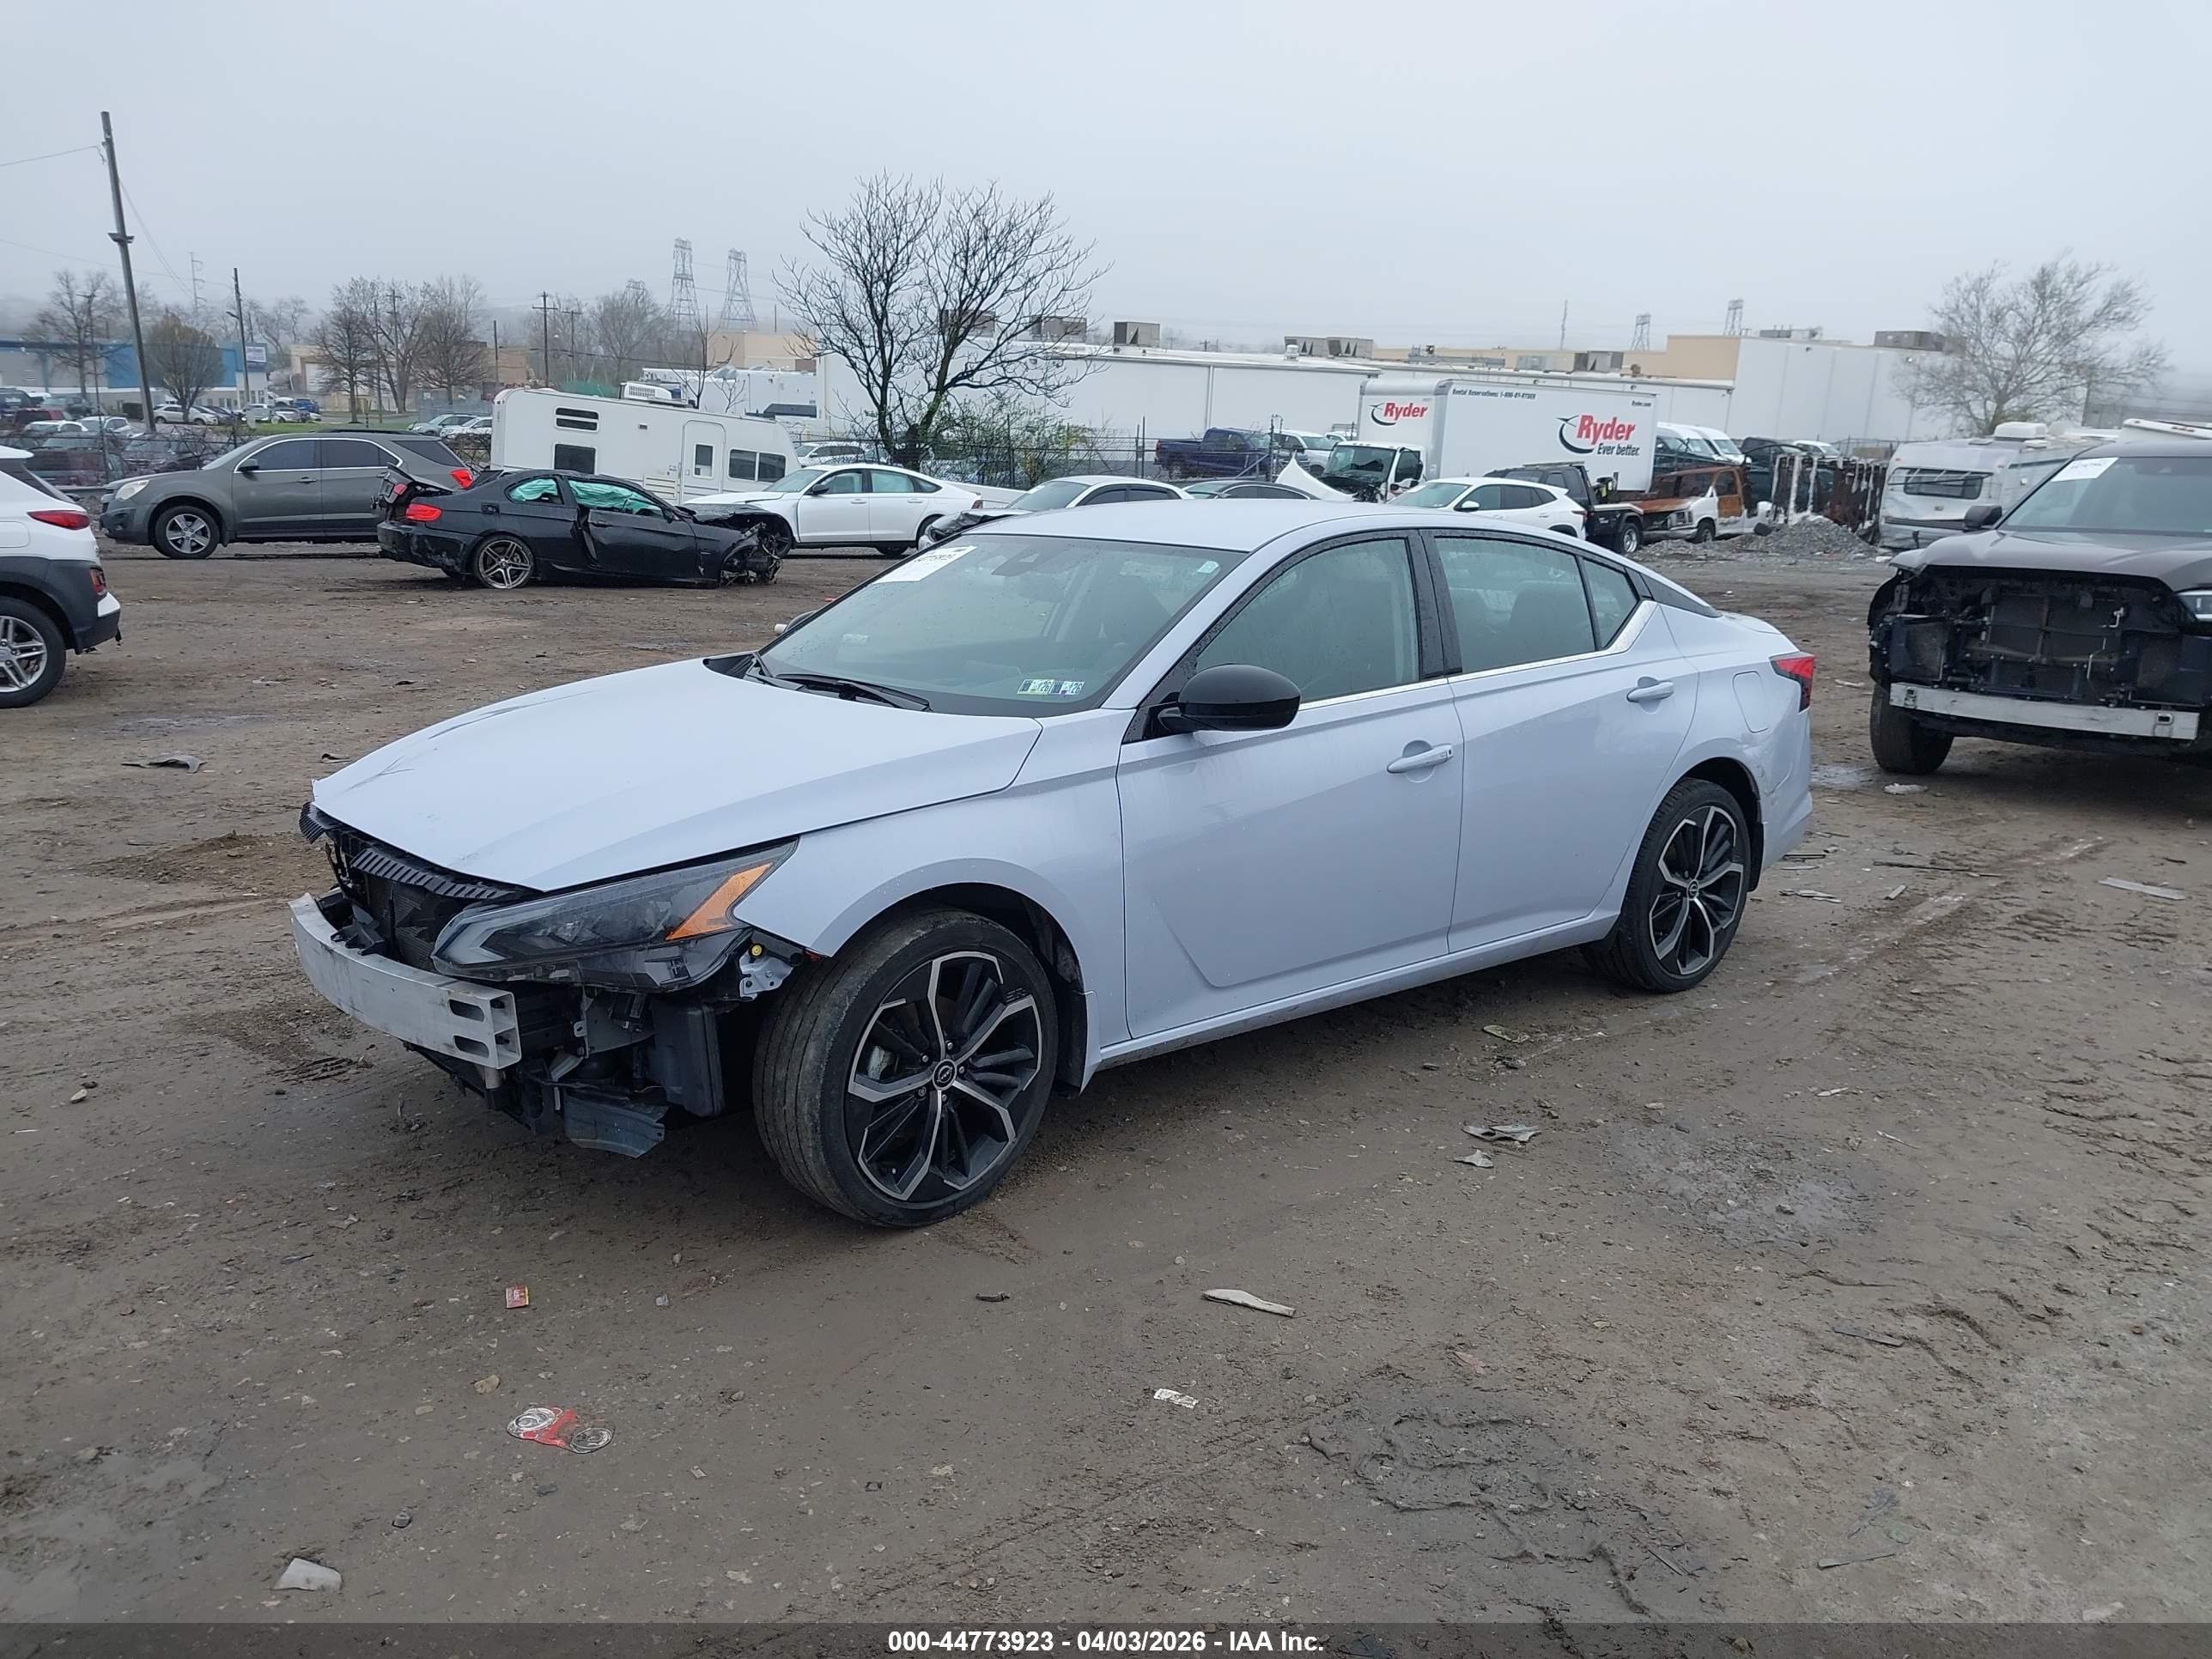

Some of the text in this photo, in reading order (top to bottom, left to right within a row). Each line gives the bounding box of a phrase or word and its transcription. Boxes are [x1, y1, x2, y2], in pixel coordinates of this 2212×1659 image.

[1383, 402, 1428, 421] Ryder
[1577, 415, 1636, 446] Ryder
[1597, 442, 1616, 455] Ever
